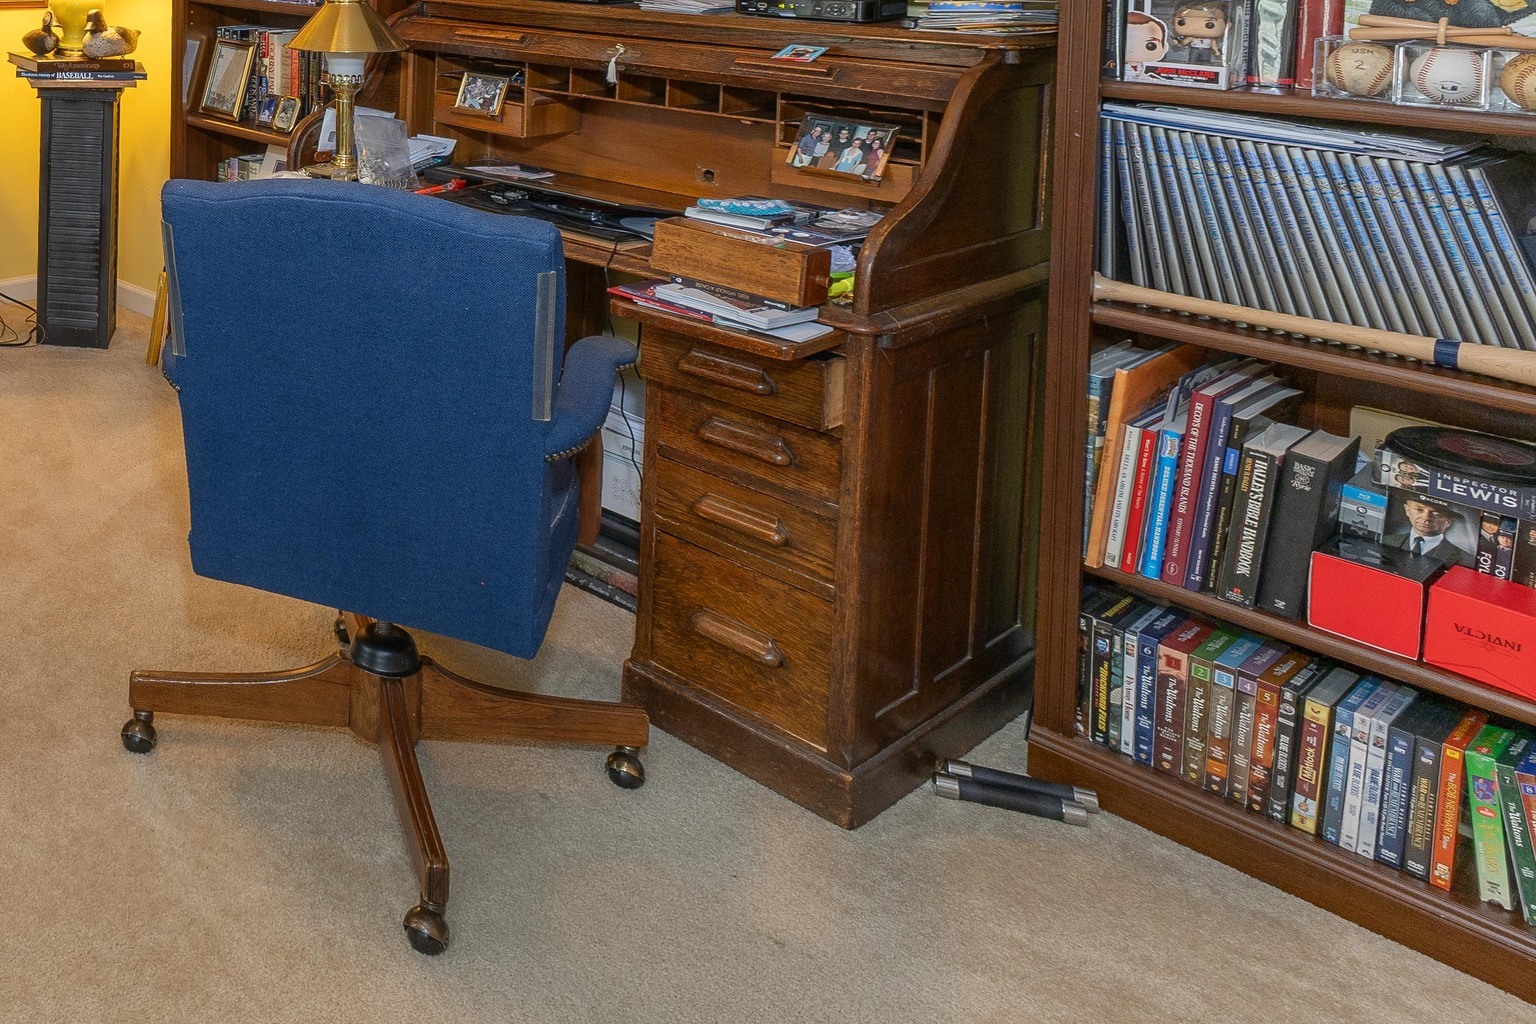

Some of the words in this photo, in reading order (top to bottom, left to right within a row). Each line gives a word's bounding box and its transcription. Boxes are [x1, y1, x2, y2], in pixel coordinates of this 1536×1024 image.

[1352, 47, 1374, 55] USM
[1155, 67, 1176, 75] JOHN
[1354, 60, 1367, 70] 2
[56, 71, 94, 79] BASEBALL
[695, 281, 711, 291] CAUSE
[715, 286, 737, 297] WITHOUT
[1192, 402, 1203, 427] DECOYS
[1190, 427, 1200, 437] OF
[1188, 437, 1197, 451] THE
[1181, 452, 1195, 487] THOUSAND
[1294, 462, 1315, 471] BASIC
[1160, 466, 1170, 491] DELUXE
[1249, 456, 1268, 499] HALLEY'S
[1437, 472, 1518, 497] INSPECTOR
[1178, 486, 1190, 514] ISLANDS
[1427, 497, 1449, 506] ACORN
[1436, 479, 1518, 508] LEWIS
[1156, 492, 1167, 526] ESSENTIAL
[1244, 500, 1262, 527] BIBLE
[1151, 527, 1162, 561] HANDBOOK
[1236, 526, 1258, 576] HANDBOOK
[588, 582, 610, 597] Southern
[1454, 622, 1523, 653] INVICTA
[1144, 646, 1152, 655] 6
[1197, 668, 1205, 676] 2
[1221, 675, 1228, 684] 3
[1098, 667, 1109, 708] ROCKFORD
[1141, 676, 1152, 709] Waltons
[1244, 682, 1251, 691] 4
[1166, 689, 1178, 722] Waltons
[1263, 692, 1271, 701] 5
[1097, 709, 1107, 733] FILES
[1123, 702, 1133, 721] Home
[1192, 698, 1204, 733] Waltons
[1214, 706, 1227, 740] Waltons
[1238, 712, 1250, 747] Waltons
[1256, 723, 1270, 758] Waltons
[1279, 734, 1290, 753] BLUE
[1277, 752, 1289, 772] BLOODS
[1302, 747, 1316, 783] Matlock
[1335, 756, 1345, 772] BLUE
[1353, 762, 1363, 778] BLUE
[1333, 772, 1344, 791] BLOODS
[1370, 769, 1381, 786] BLUE
[1392, 767, 1402, 783] WAR
[1448, 772, 1456, 783] The
[1350, 778, 1361, 797] BLOODS
[1367, 785, 1379, 805] BLOODS
[1418, 778, 1429, 794] WAR
[1447, 782, 1457, 800] BOB
[1386, 790, 1400, 838] REMEMBRANCE
[1508, 802, 1516, 814] The
[1414, 801, 1426, 849] REMEMBRANCE
[1444, 800, 1455, 837] NEWHART
[1509, 813, 1524, 847] Waltons
[1442, 836, 1451, 850] Show
